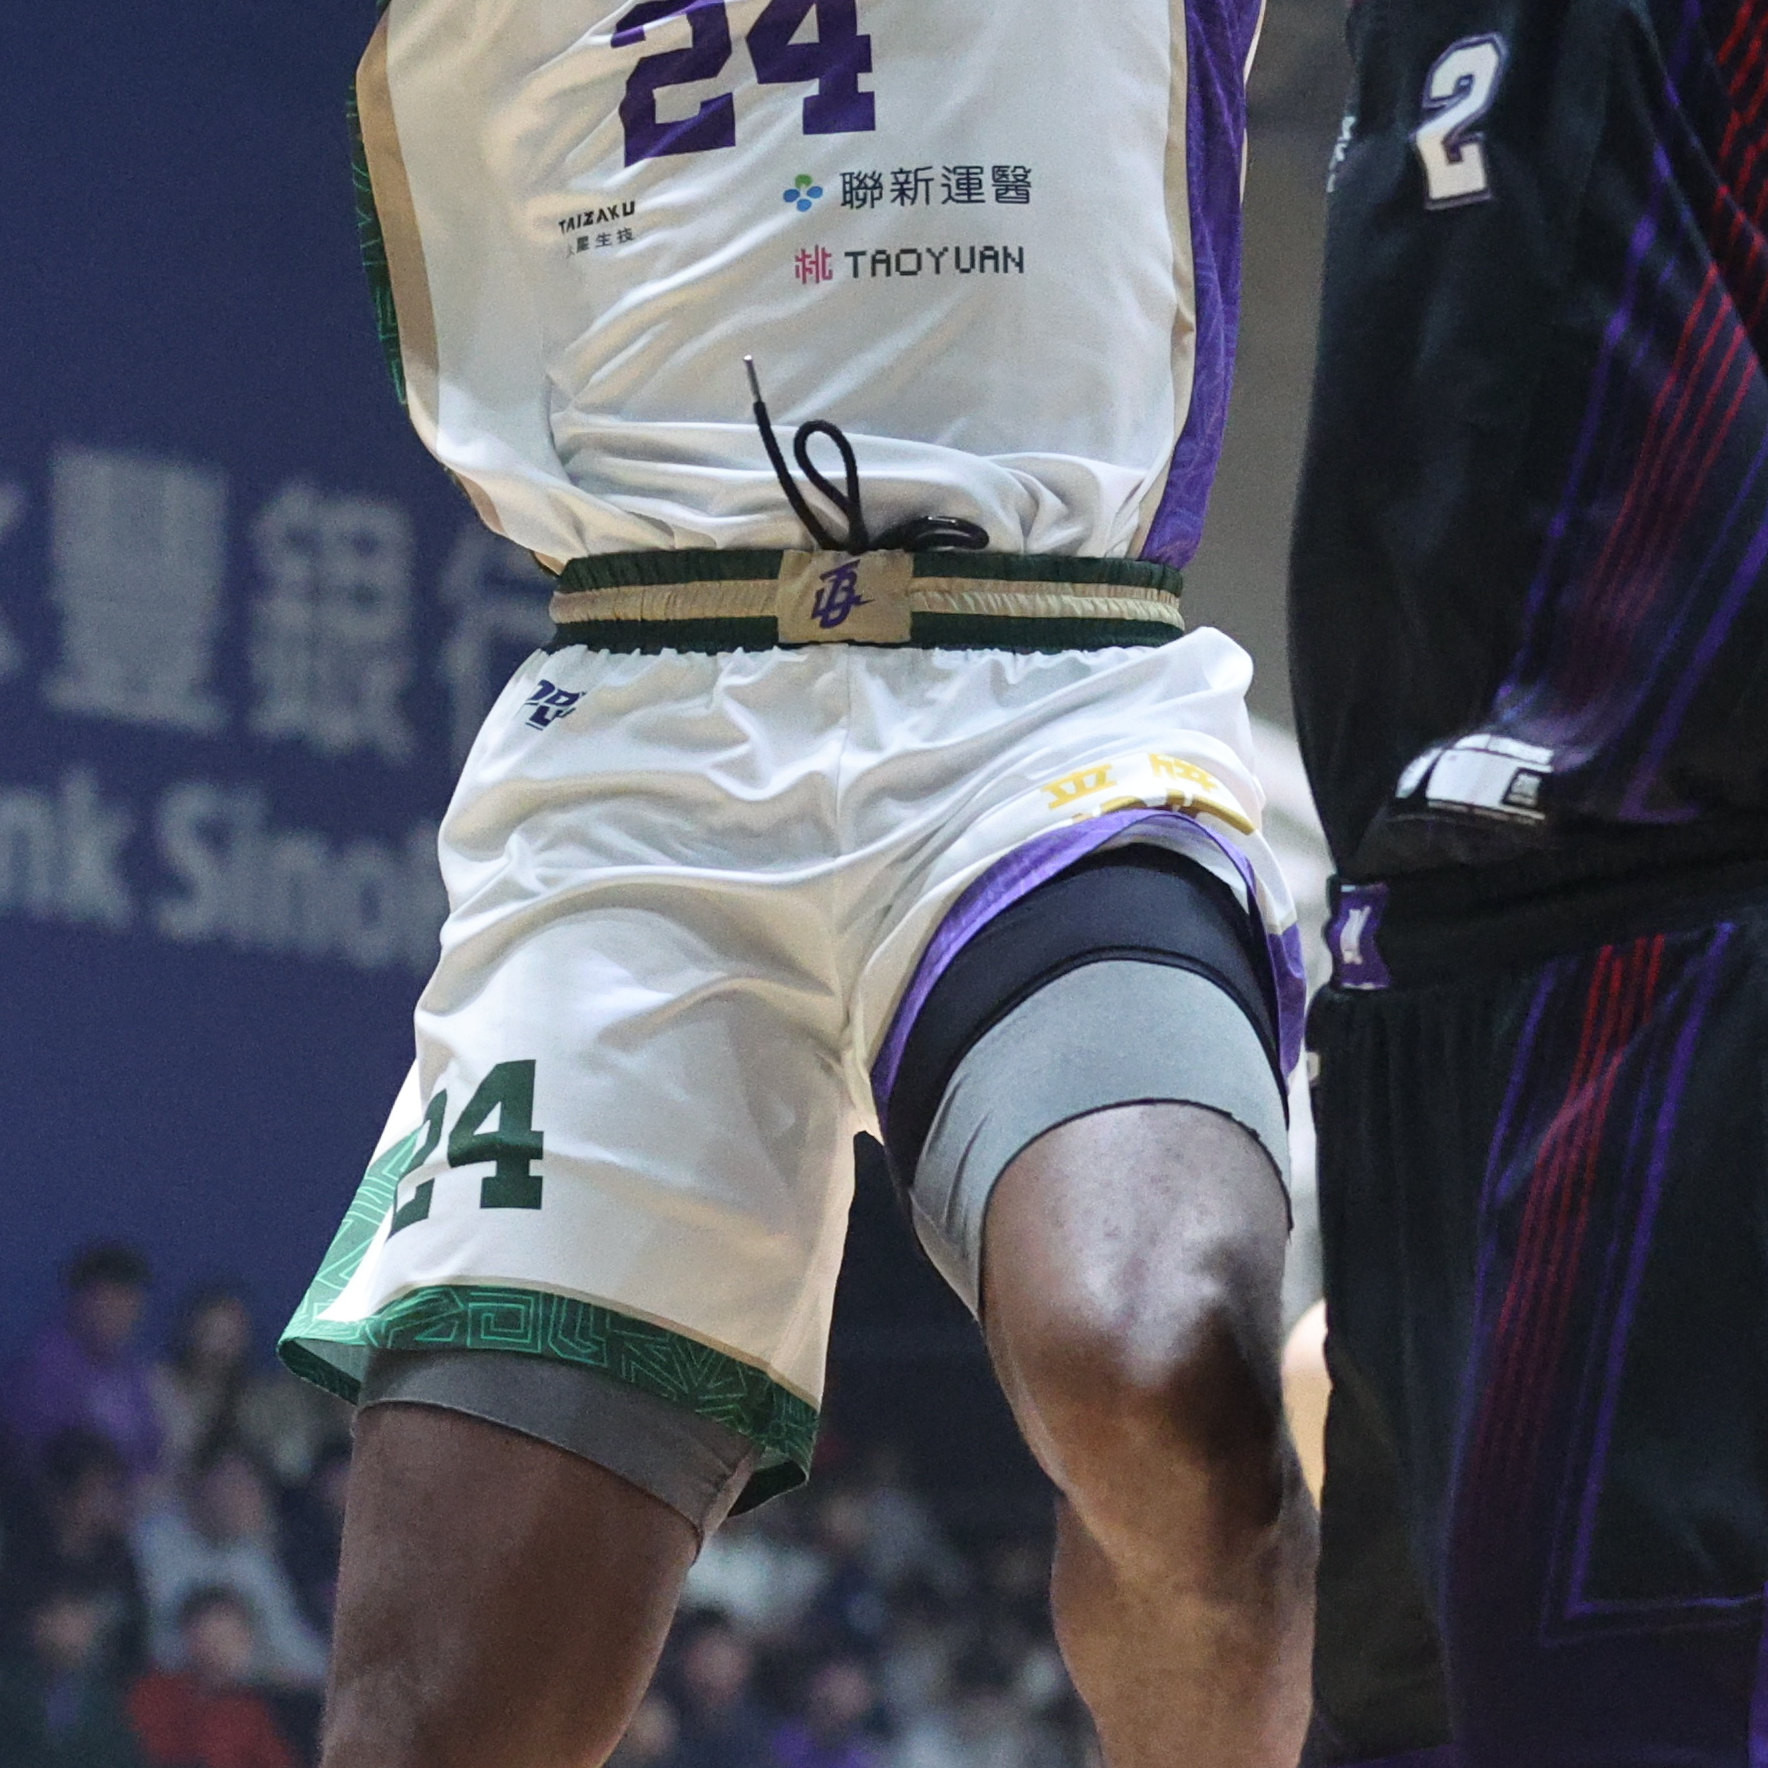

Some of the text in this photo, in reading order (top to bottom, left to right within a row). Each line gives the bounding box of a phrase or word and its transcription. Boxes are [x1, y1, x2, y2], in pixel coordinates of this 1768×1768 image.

[1412, 35, 1505, 208] 2
[840, 165, 1033, 209] 聯新運醫
[558, 201, 636, 234] TAIZAKU
[844, 245, 1025, 280] TAOYUAN
